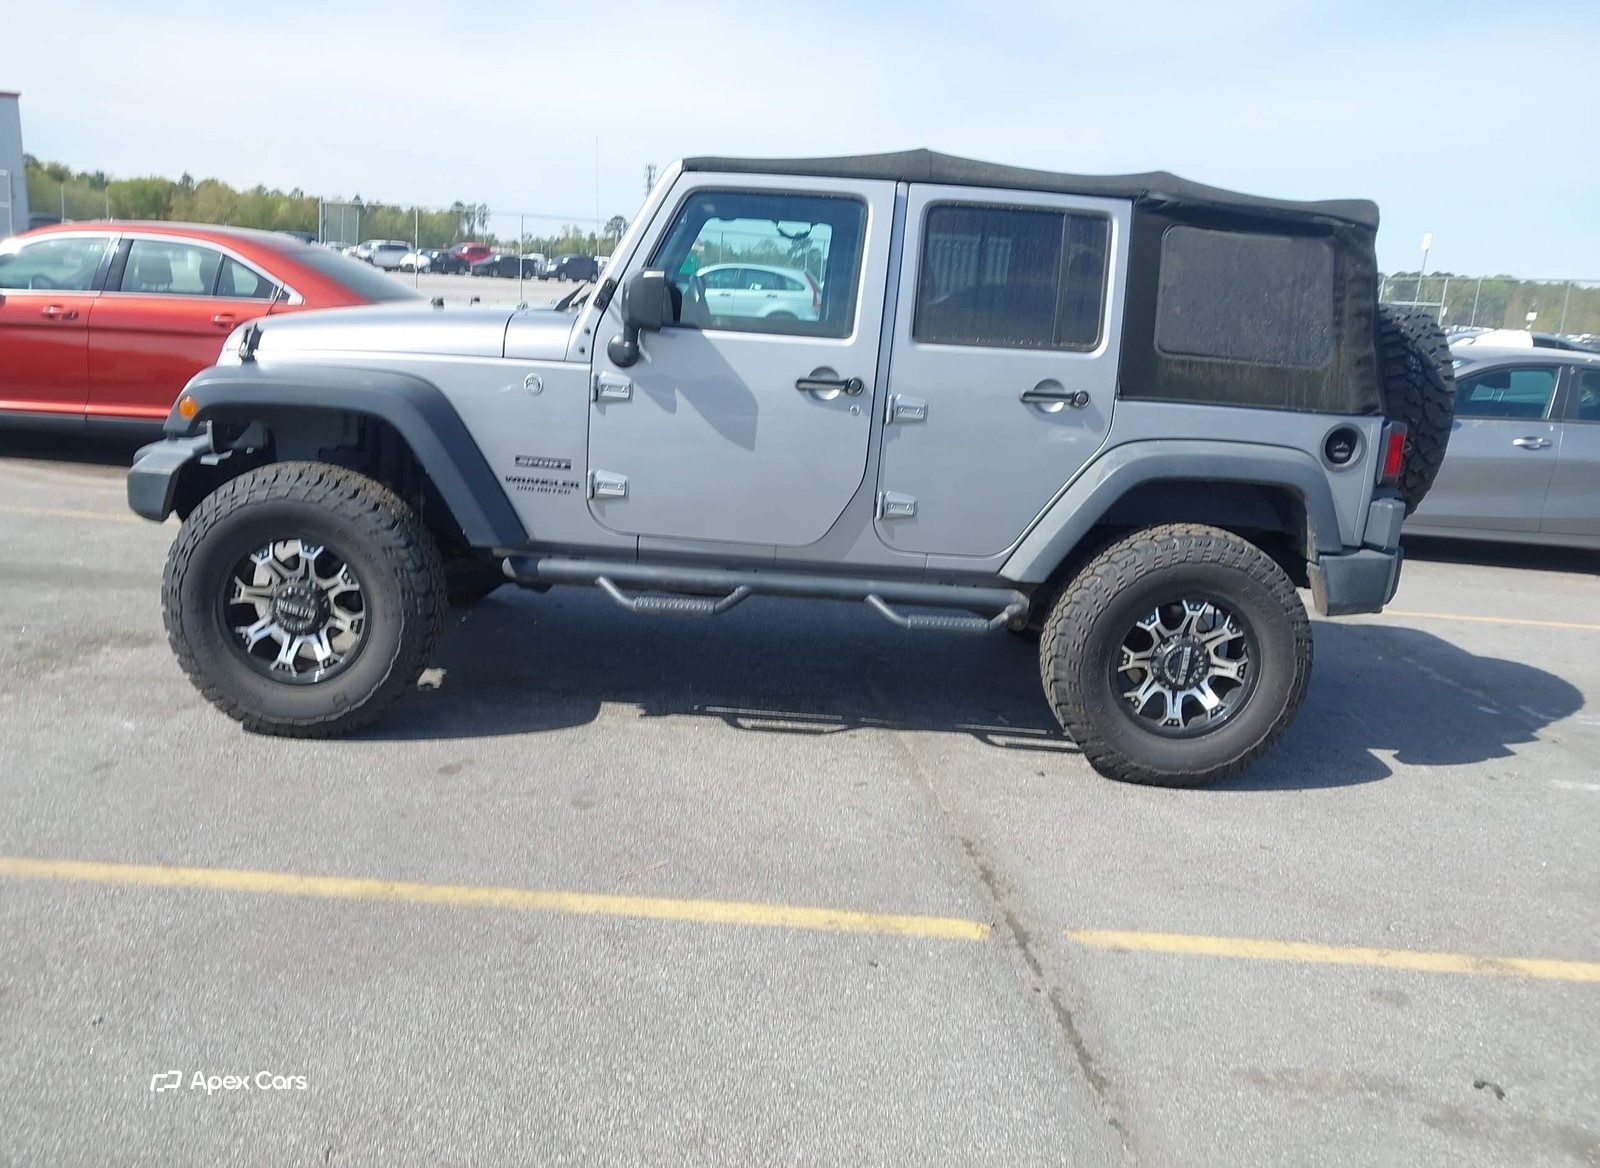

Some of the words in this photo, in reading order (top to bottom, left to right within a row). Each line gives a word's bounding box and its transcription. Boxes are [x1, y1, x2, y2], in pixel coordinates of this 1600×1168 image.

[515, 454, 572, 471] SPORT
[505, 474, 580, 490] WRANGLER
[516, 484, 572, 495] UNLIMITED
